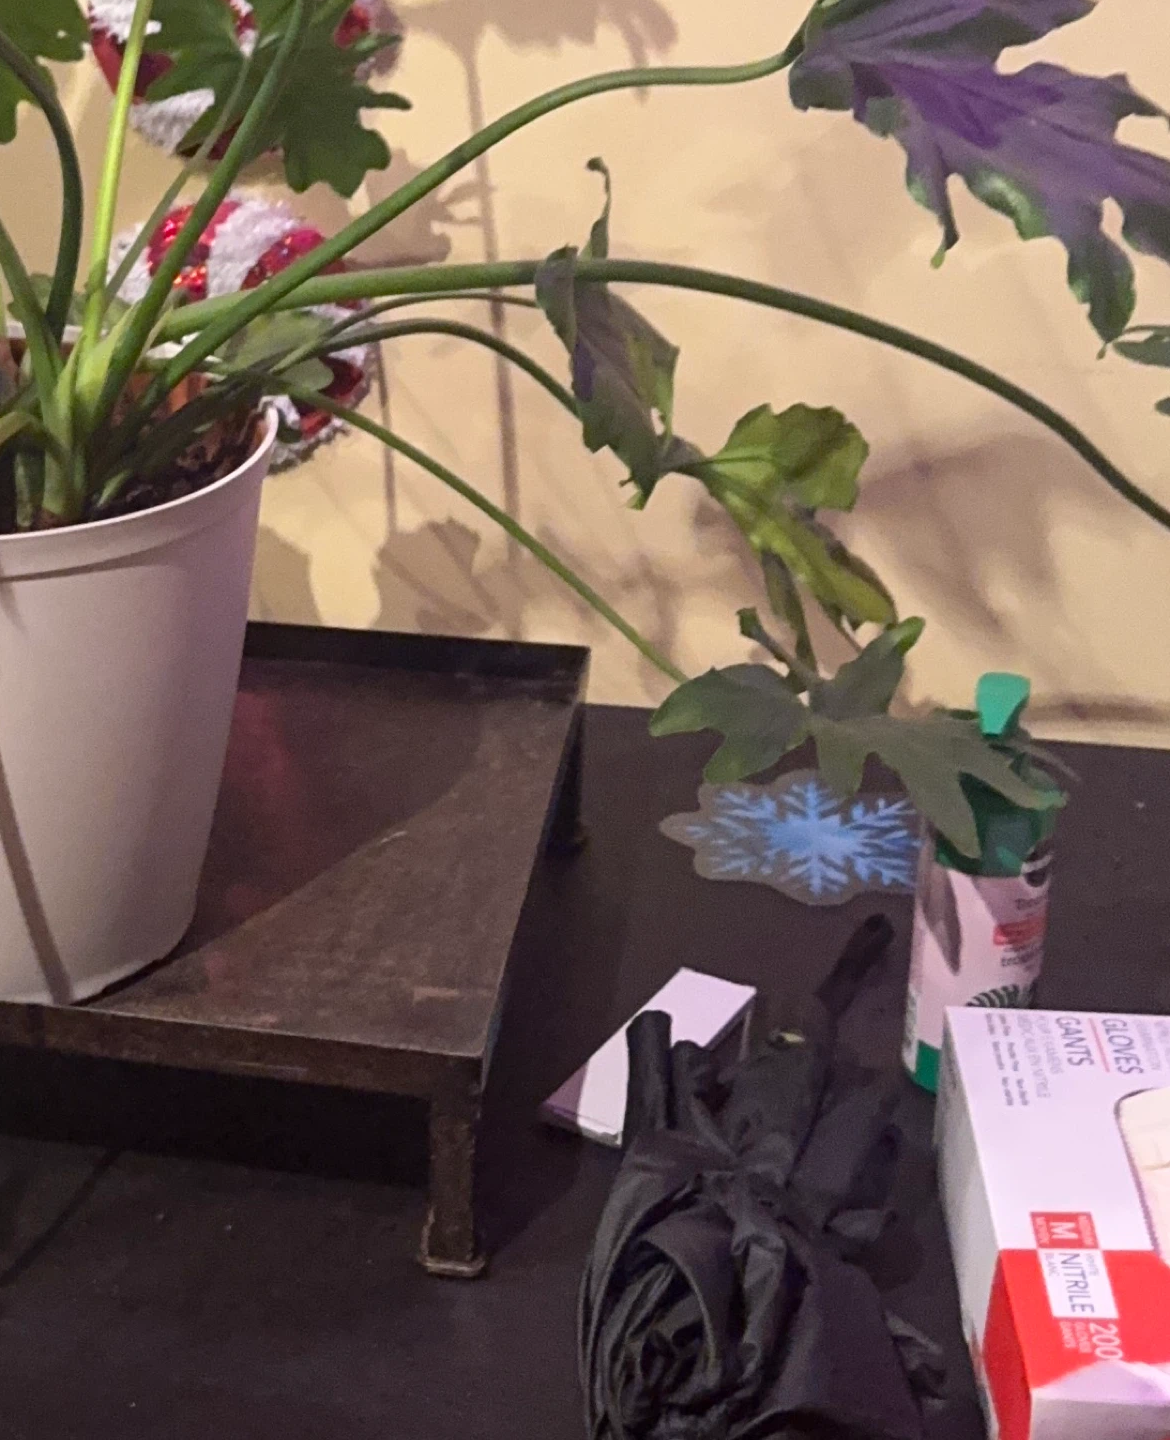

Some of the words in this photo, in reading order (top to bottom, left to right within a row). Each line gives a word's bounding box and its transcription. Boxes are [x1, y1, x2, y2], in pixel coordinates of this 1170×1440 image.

[1056, 1016, 1095, 1066] GANTS
[1102, 1018, 1144, 1074] GLOVES
[1049, 1221, 1079, 1240] M
[1044, 1252, 1060, 1277] BLANC
[1058, 1251, 1095, 1313] NITRILE
[1060, 1321, 1076, 1349] GANTS
[1089, 1322, 1123, 1360] 200
